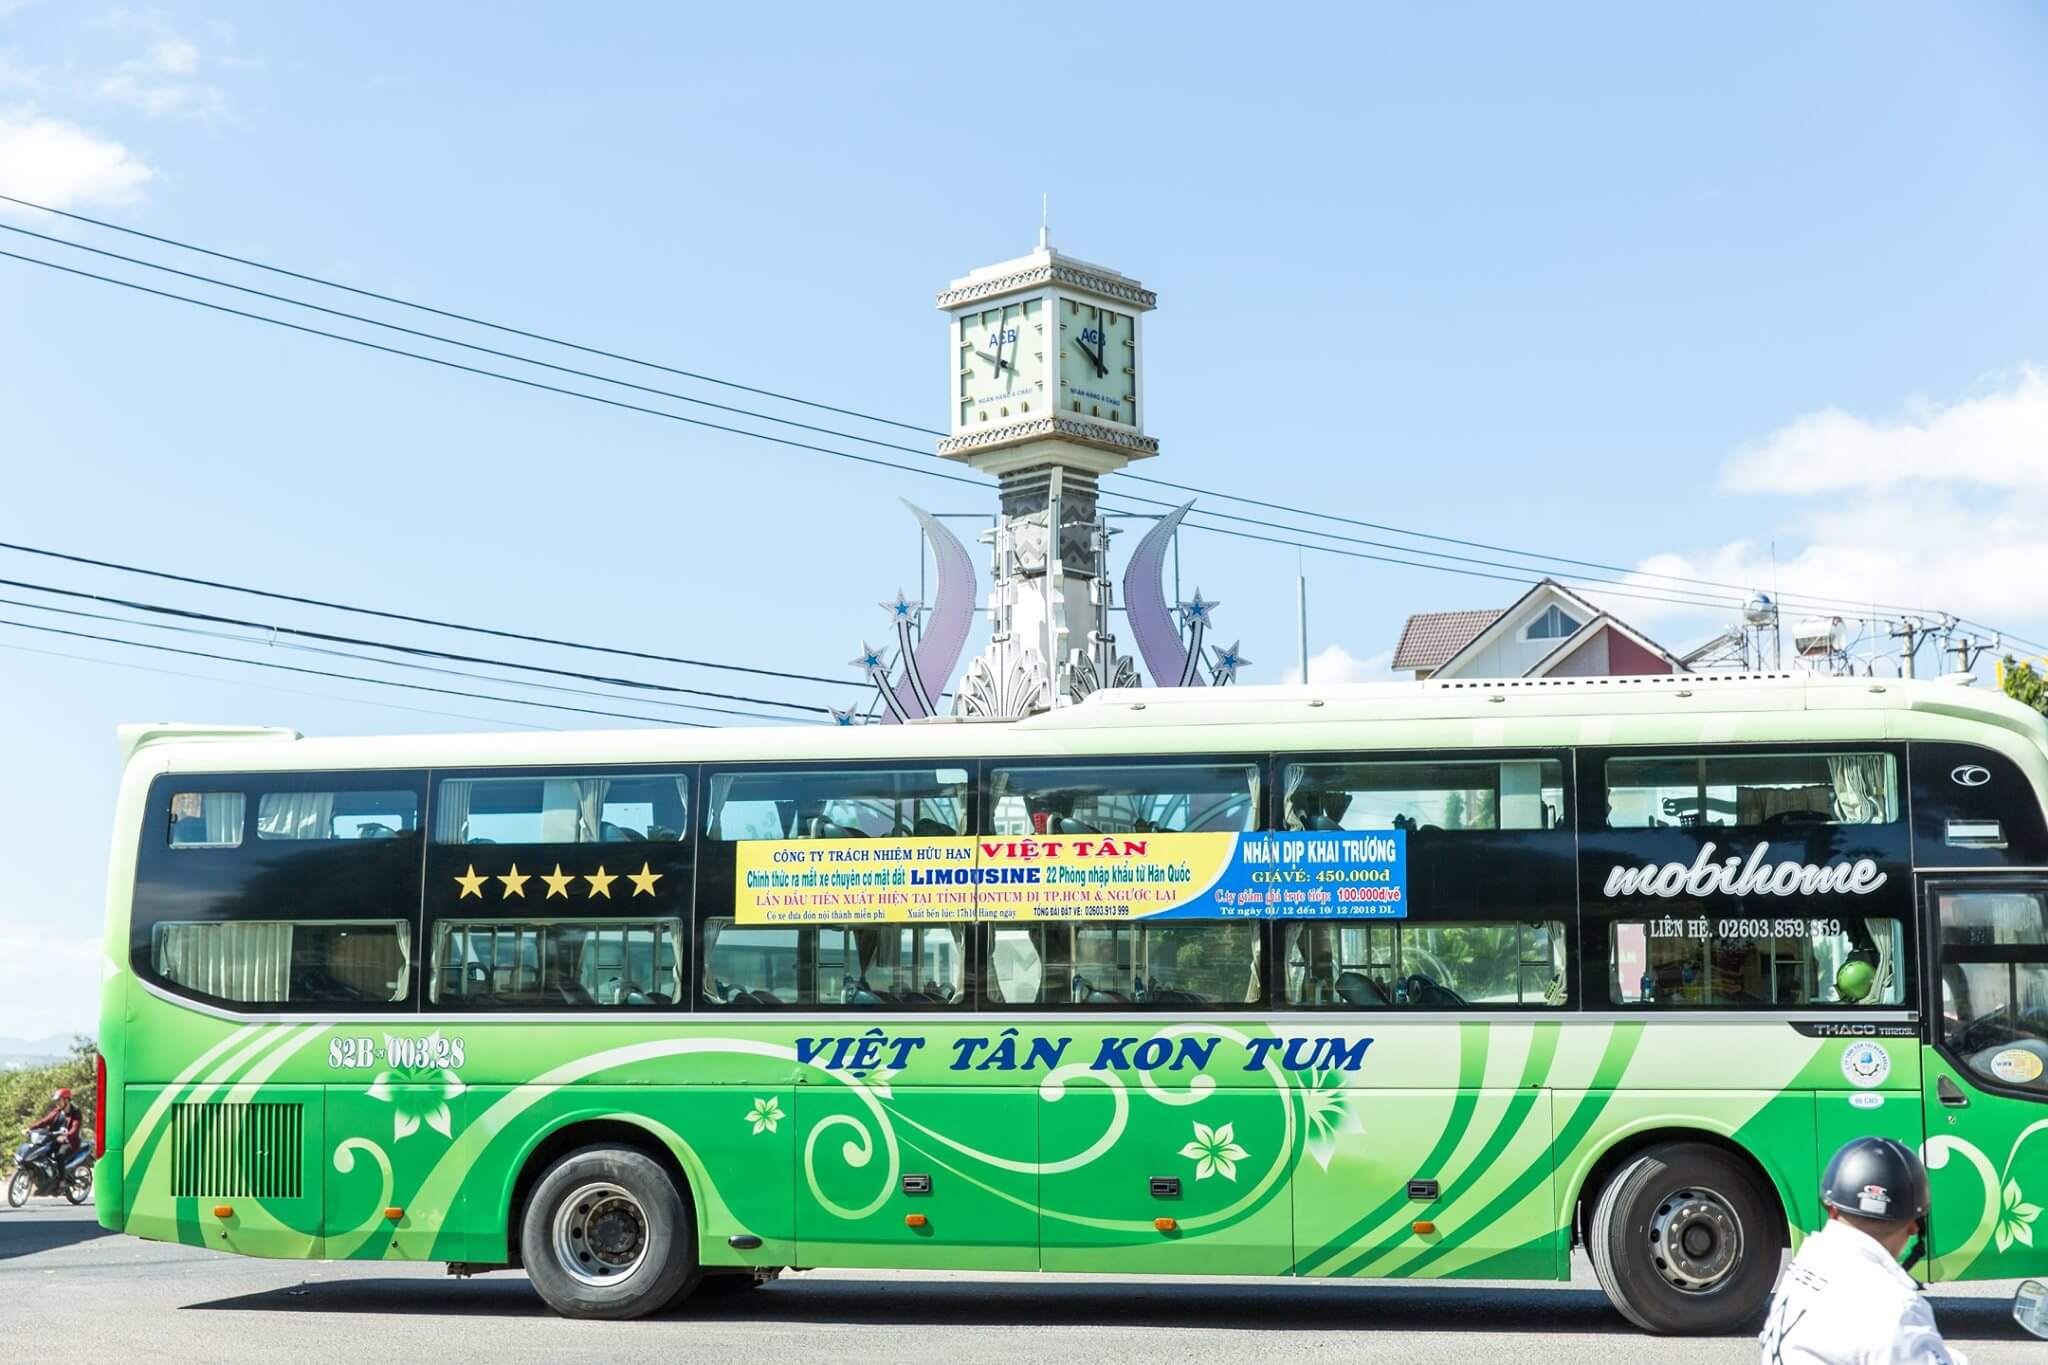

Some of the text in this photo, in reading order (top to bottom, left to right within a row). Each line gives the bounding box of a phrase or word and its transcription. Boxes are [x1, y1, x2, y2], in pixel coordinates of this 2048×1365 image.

[773, 837, 1148, 863] CÔNG TY TRÁCH NHIỆM HỮU HẠN VIỆT TÂN
[1243, 835, 1396, 870] NHÂN DỊP KHAI TRƯƠNG
[747, 860, 1191, 890] Chính thức ra mắt xe chuyên cơ mặt đất LIMOUSINE 22 Phòng nhập khẩu từ Hàn Quốc
[1316, 868, 1390, 883] 450.000đ
[1603, 840, 1888, 898] mobihome
[756, 890, 780, 906] LẦN
[784, 889, 807, 906] ĐẦU
[812, 891, 839, 905] TIÊN
[843, 890, 874, 905] XUẤT
[878, 890, 908, 906] HIỆN
[912, 892, 932, 905] TẠI
[937, 888, 966, 904] TỈNH
[970, 890, 1021, 904] KONTUM
[1044, 889, 1090, 903] TP.HCM
[1094, 890, 1103, 902] &
[1108, 888, 1151, 904] NGƯỢC
[1156, 889, 1176, 903] LẠI
[1117, 905, 1129, 916] 999
[1220, 906, 1235, 915] Từ
[1238, 906, 1262, 917] ngày
[1296, 904, 1316, 915] đến
[1650, 914, 1683, 938] LIÊN
[1718, 918, 1841, 939] 02603.859.859
[1813, 1024, 1876, 1035] THACO
[328, 1037, 465, 1069] 82B 003.28
[794, 1027, 1375, 1078] VIỆT TÂN KON TUM
